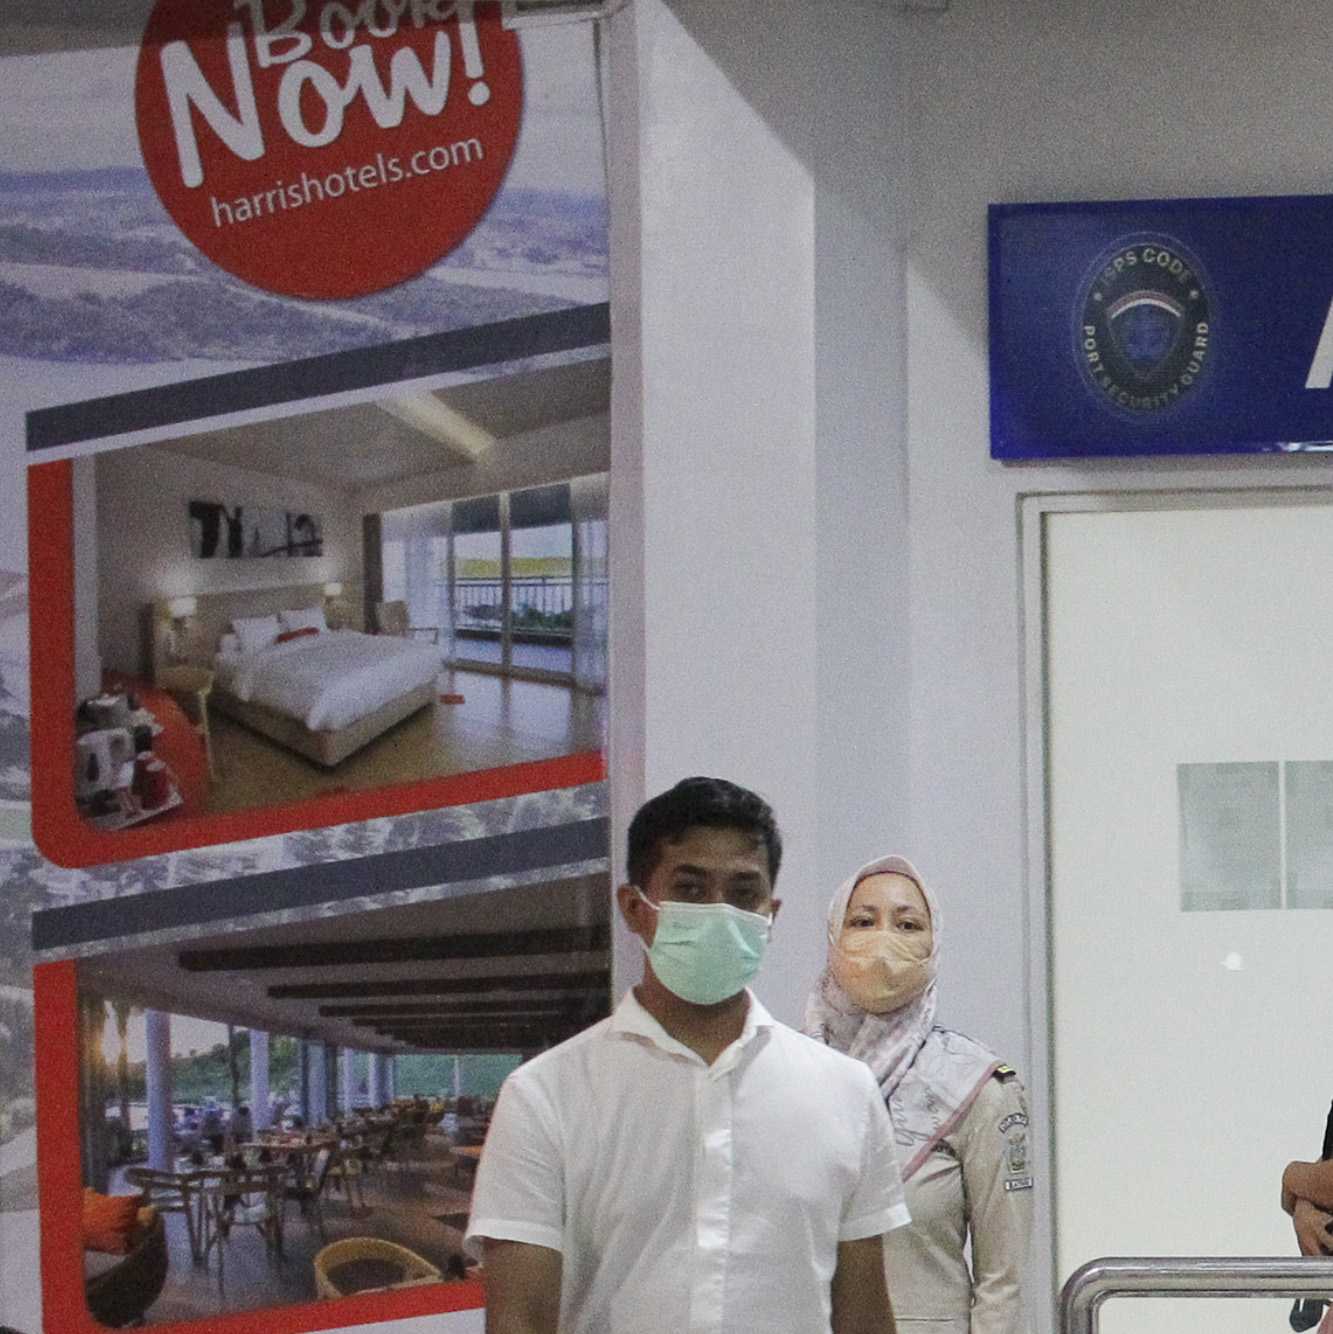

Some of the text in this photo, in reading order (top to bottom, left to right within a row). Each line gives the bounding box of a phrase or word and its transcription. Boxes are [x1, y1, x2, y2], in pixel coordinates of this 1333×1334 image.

[211, 138, 484, 227] harrishotels.com
[1142, 248, 1192, 284] CODE
[1083, 325, 1105, 374] PORT
